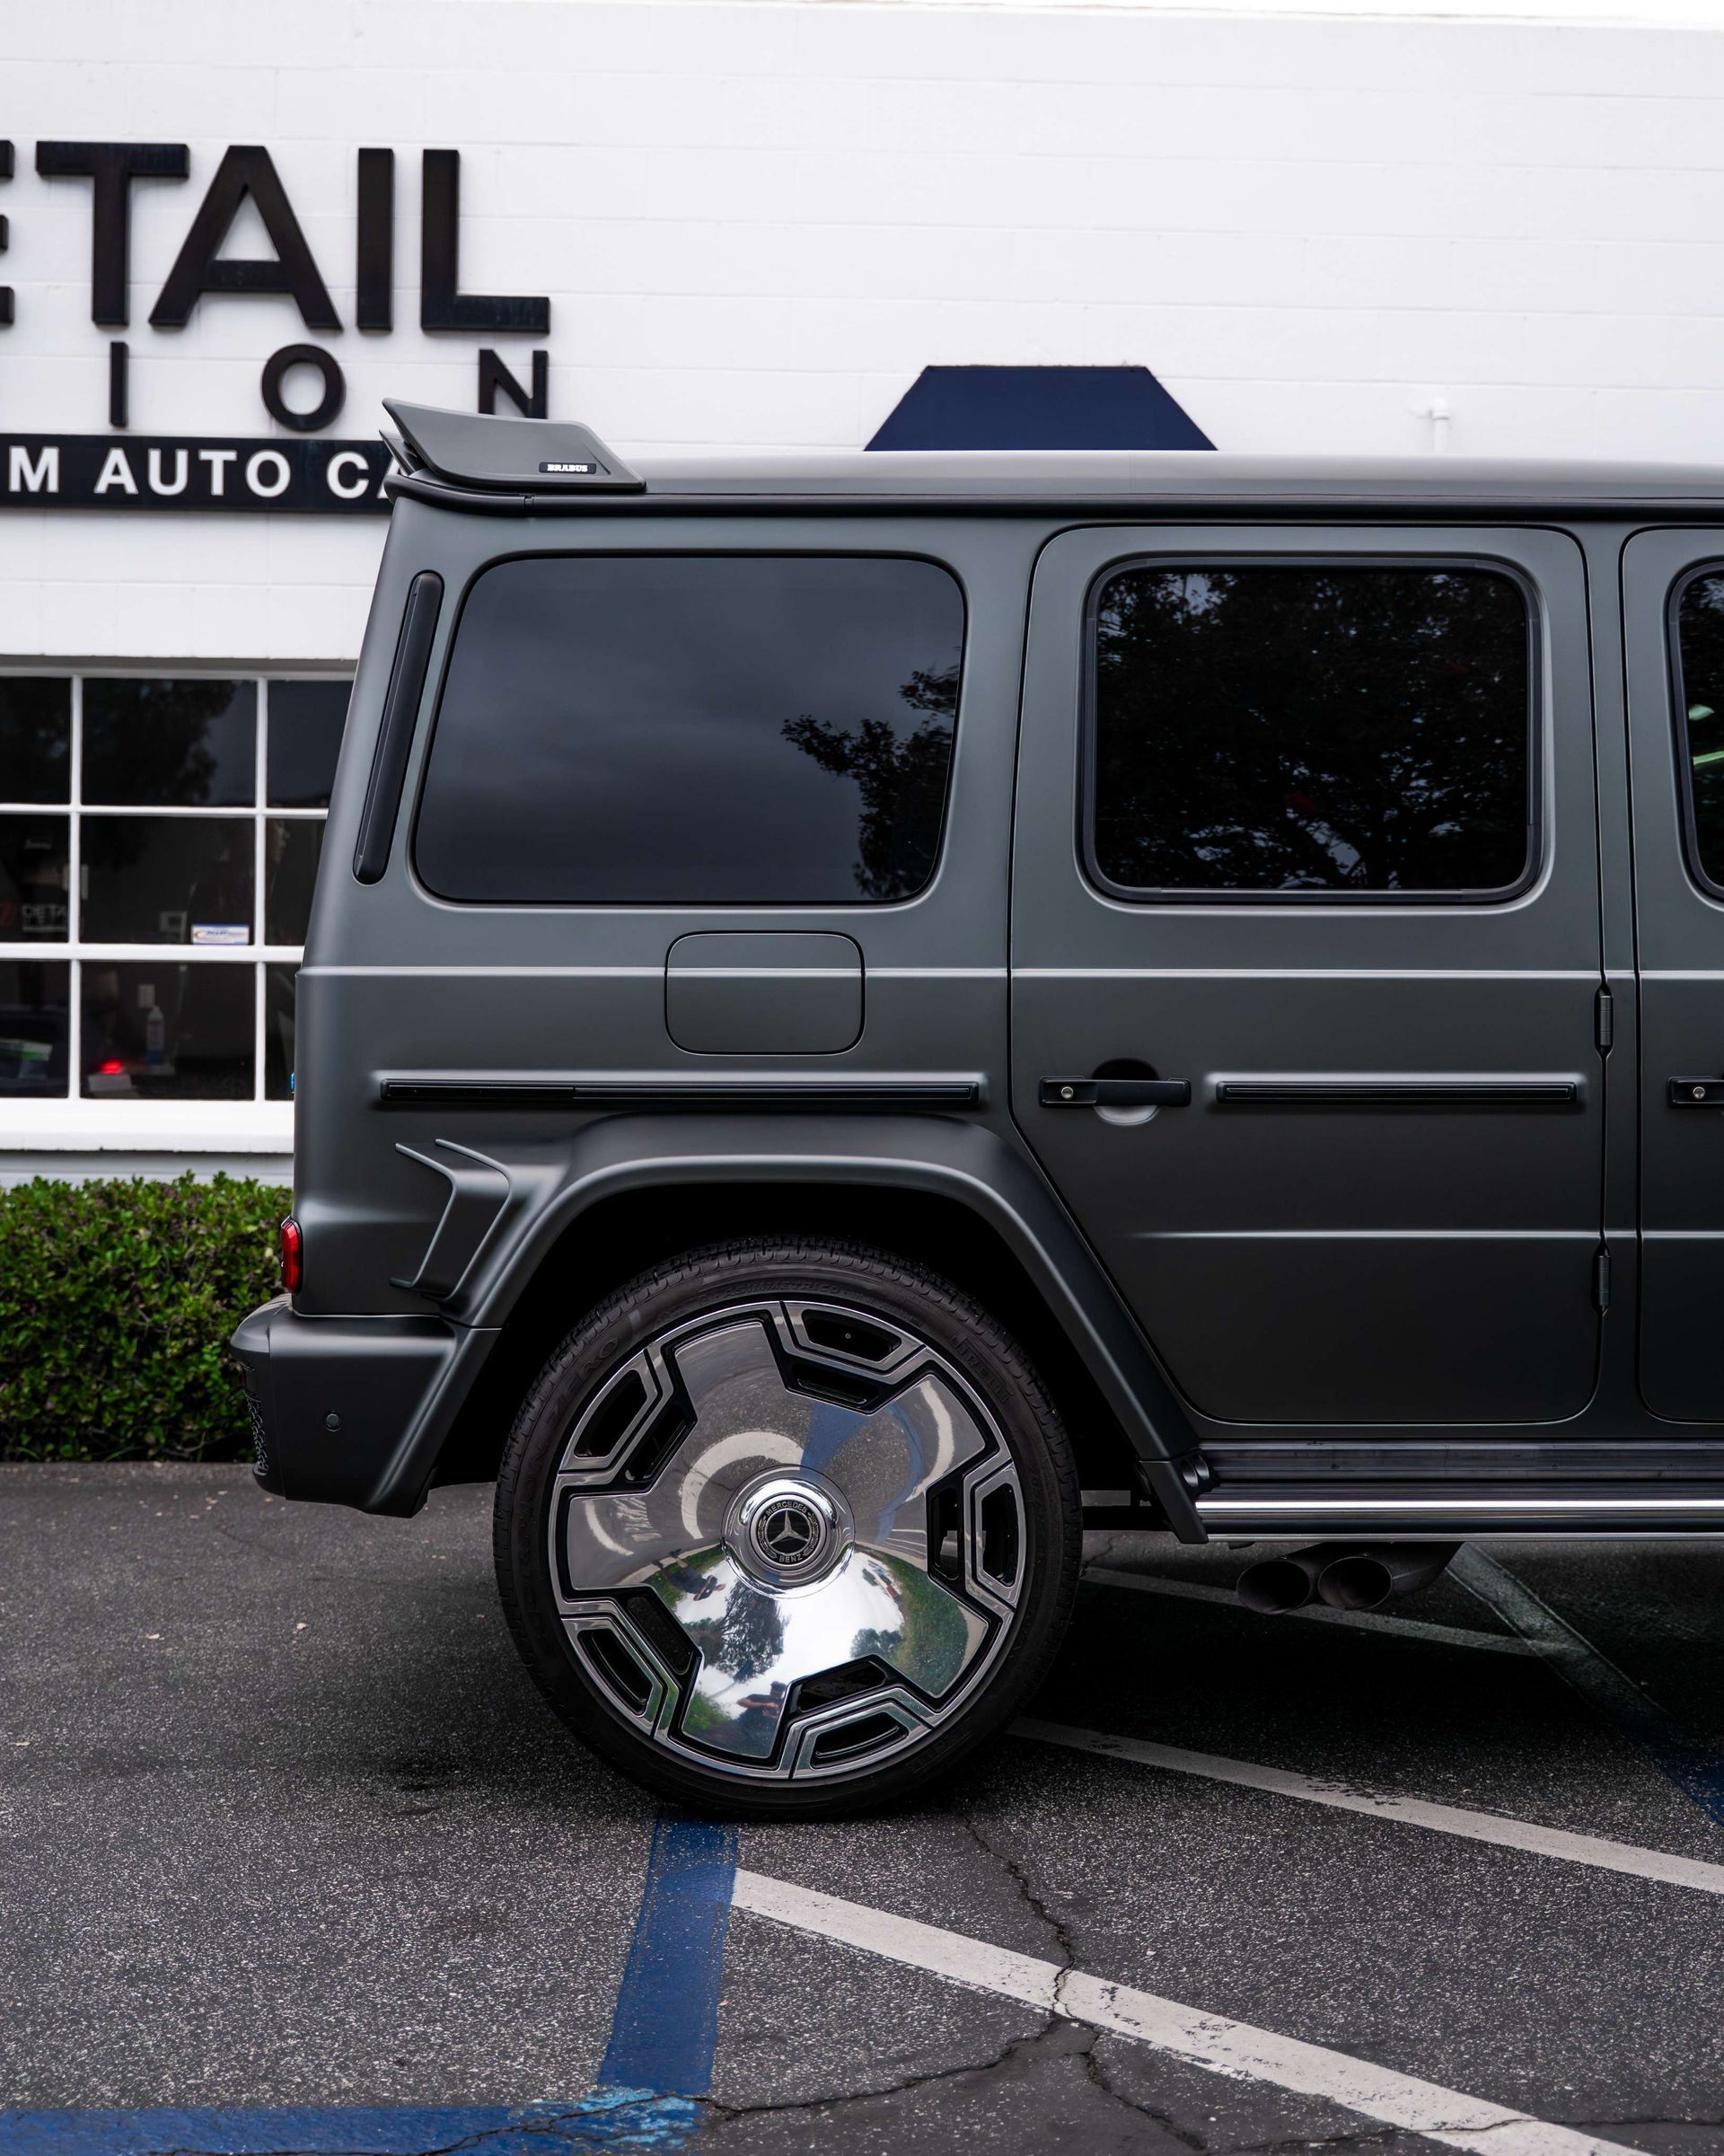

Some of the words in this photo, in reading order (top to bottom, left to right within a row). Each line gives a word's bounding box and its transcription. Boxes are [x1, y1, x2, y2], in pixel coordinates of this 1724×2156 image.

[0, 140, 550, 334] TAIL
[94, 447, 291, 497] AUTO
[546, 463, 588, 472] BRABUS
[766, 1501, 808, 1516] MERCEDES
[779, 1554, 803, 1563] BENZ
